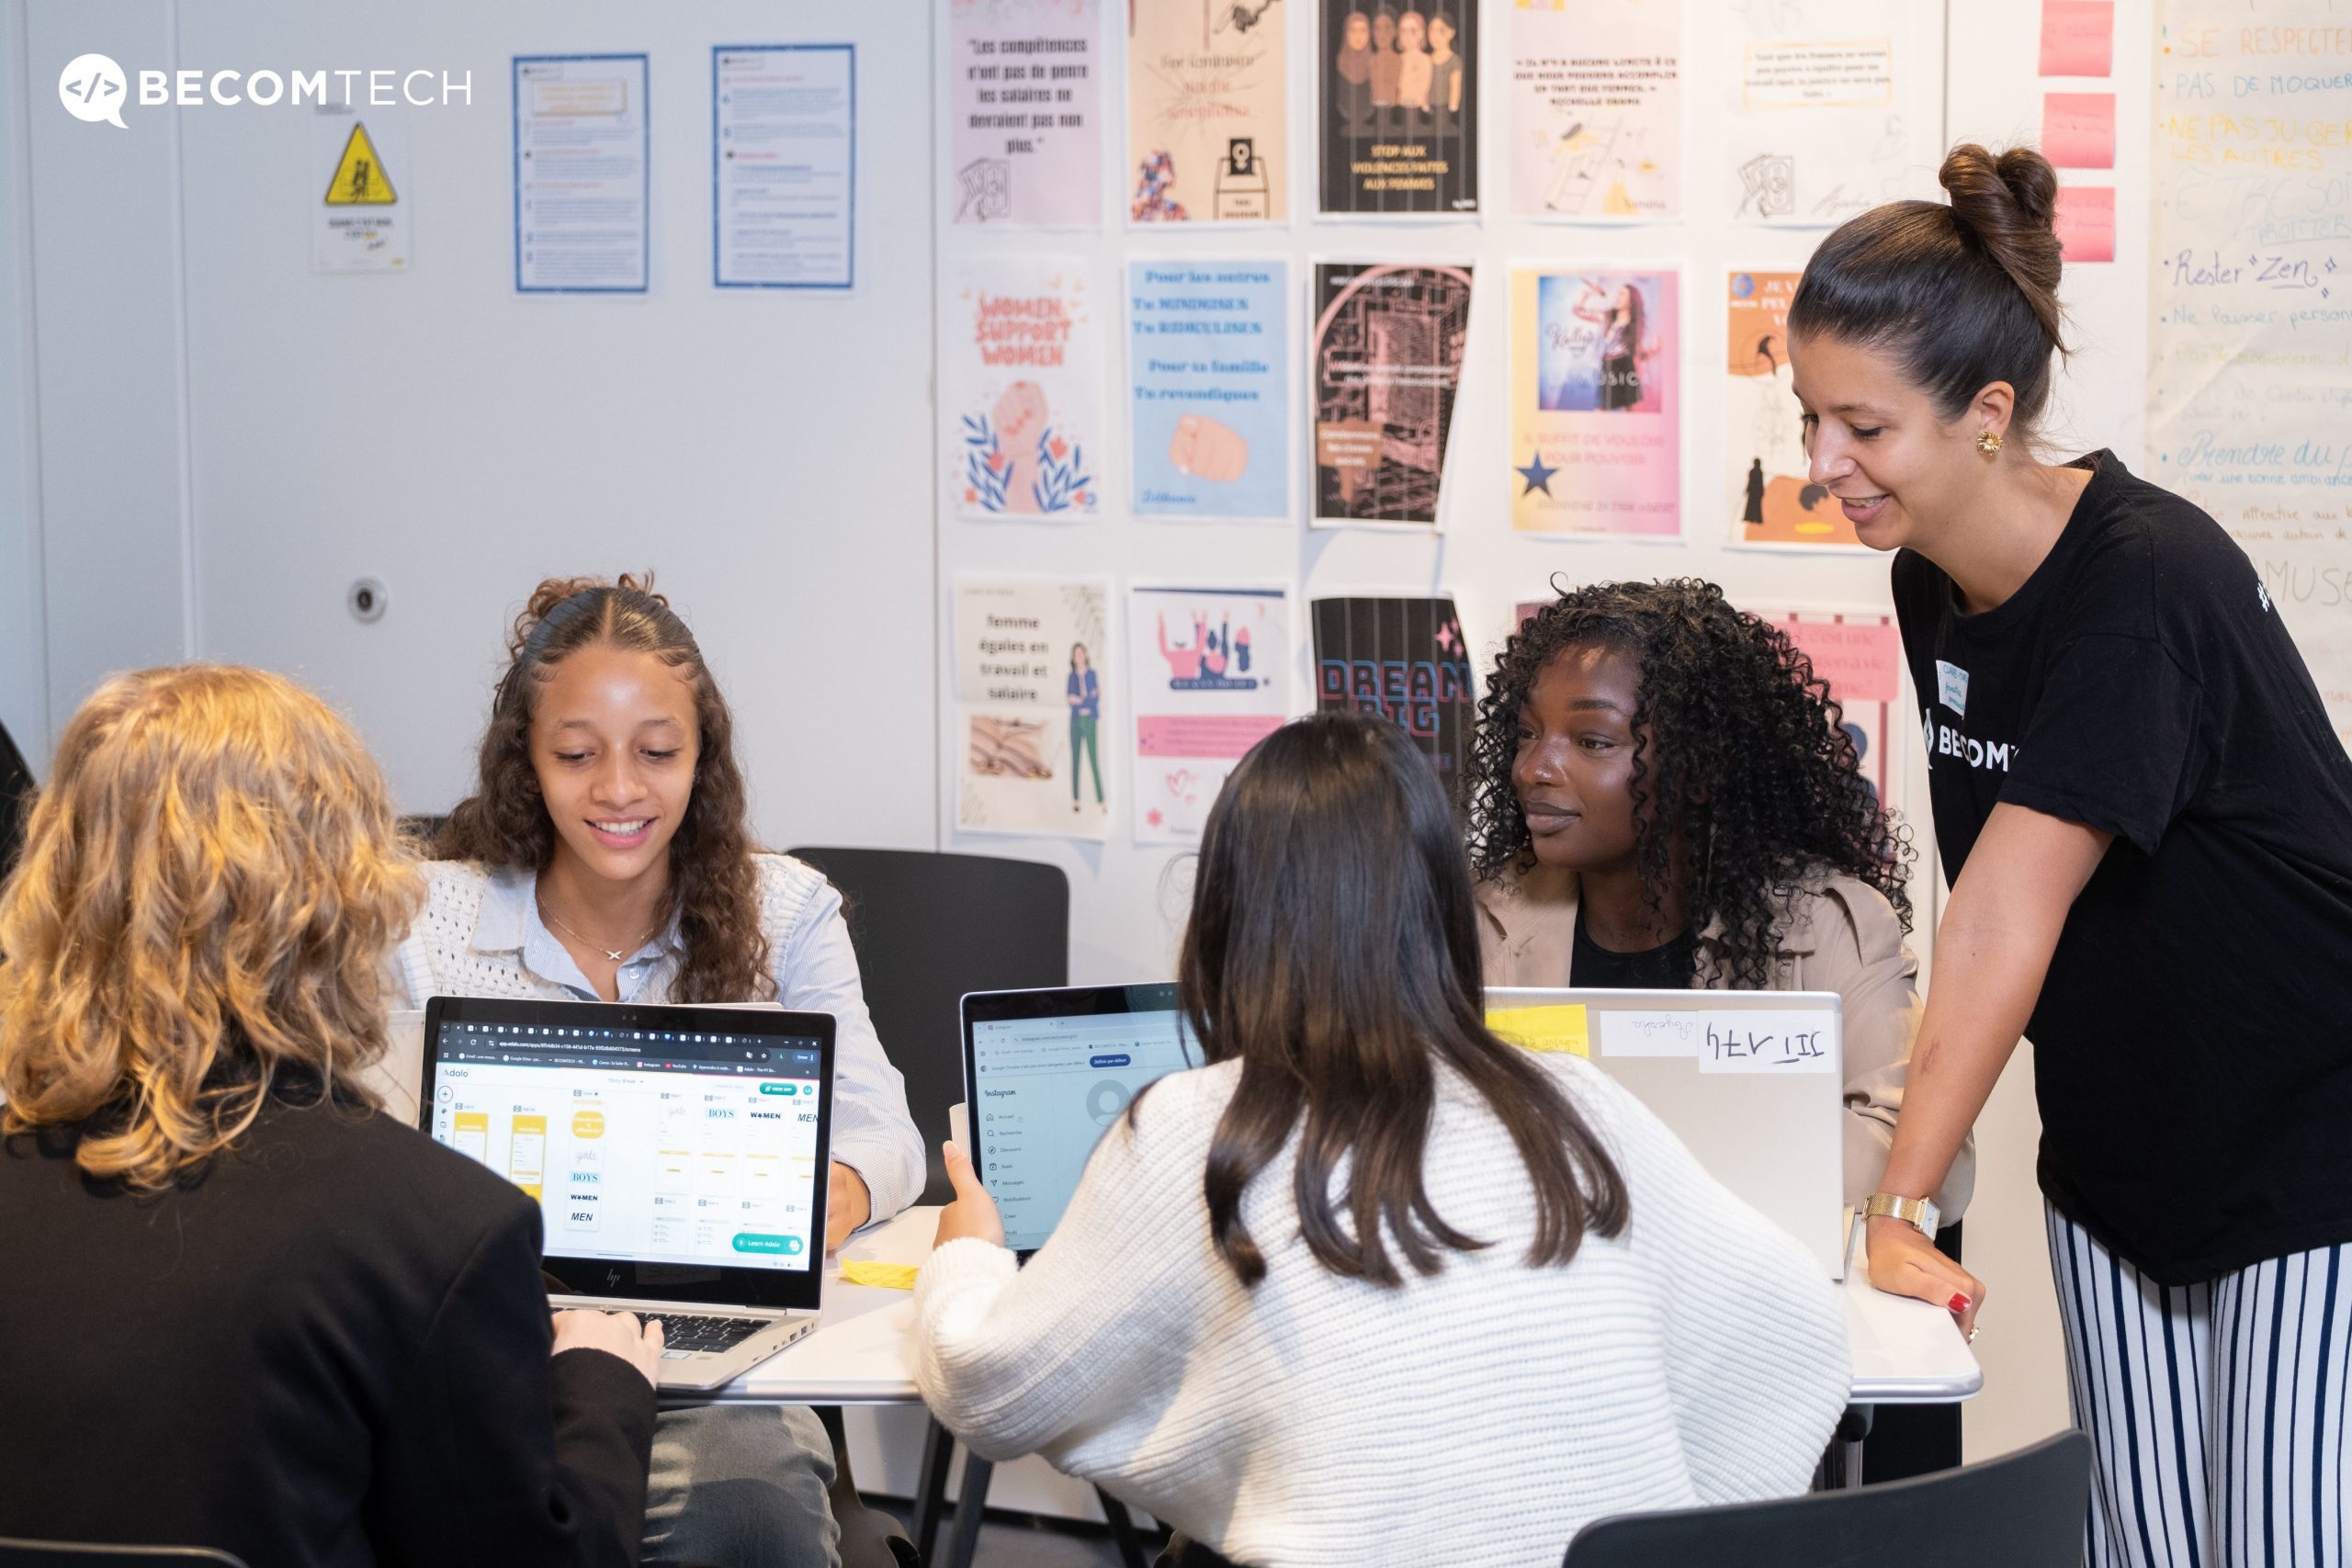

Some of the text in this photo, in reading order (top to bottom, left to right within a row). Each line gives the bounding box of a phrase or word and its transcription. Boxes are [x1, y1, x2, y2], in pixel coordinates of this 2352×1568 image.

[2177, 26, 2352, 58] SE RESPECTE
[1002, 65, 1027, 81] pas
[1030, 63, 1046, 81] de
[977, 88, 997, 103] les
[1000, 87, 1053, 103] salaires
[2176, 72, 2216, 100] PAS
[2233, 76, 2260, 98] DE
[968, 113, 1028, 129] devraient
[1030, 114, 1054, 130] pas
[2168, 116, 2200, 141] NE
[2210, 112, 2258, 140] PAS
[1370, 144, 1401, 158] STOP
[2171, 144, 2324, 171] LES AUTRES
[2173, 248, 2243, 287] Rester
[1145, 270, 1185, 284] Pour
[1216, 271, 1271, 284] autres
[978, 292, 1063, 318] WOMEN
[2173, 303, 2199, 325] Ne
[2290, 307, 2352, 332] person
[975, 318, 1072, 344] SUPPORT
[980, 344, 1064, 367] WOMEN
[1148, 358, 1187, 374] Pour
[985, 613, 1041, 631] femme
[978, 636, 1049, 657] égales en
[979, 660, 1049, 678] travail et
[1316, 660, 1473, 703] DREAM
[986, 684, 1039, 702] salaire
[1939, 725, 2019, 773] BECOM
[1705, 1020, 1774, 1061] 174
[442, 1068, 469, 1078] Adalo
[984, 1089, 1017, 1099] Instagram
[708, 1109, 734, 1119] BOYS
[797, 1113, 818, 1122] MEN
[573, 1172, 598, 1183] BOYS
[571, 1212, 594, 1222] MEN
[764, 1240, 781, 1248] Adalo
